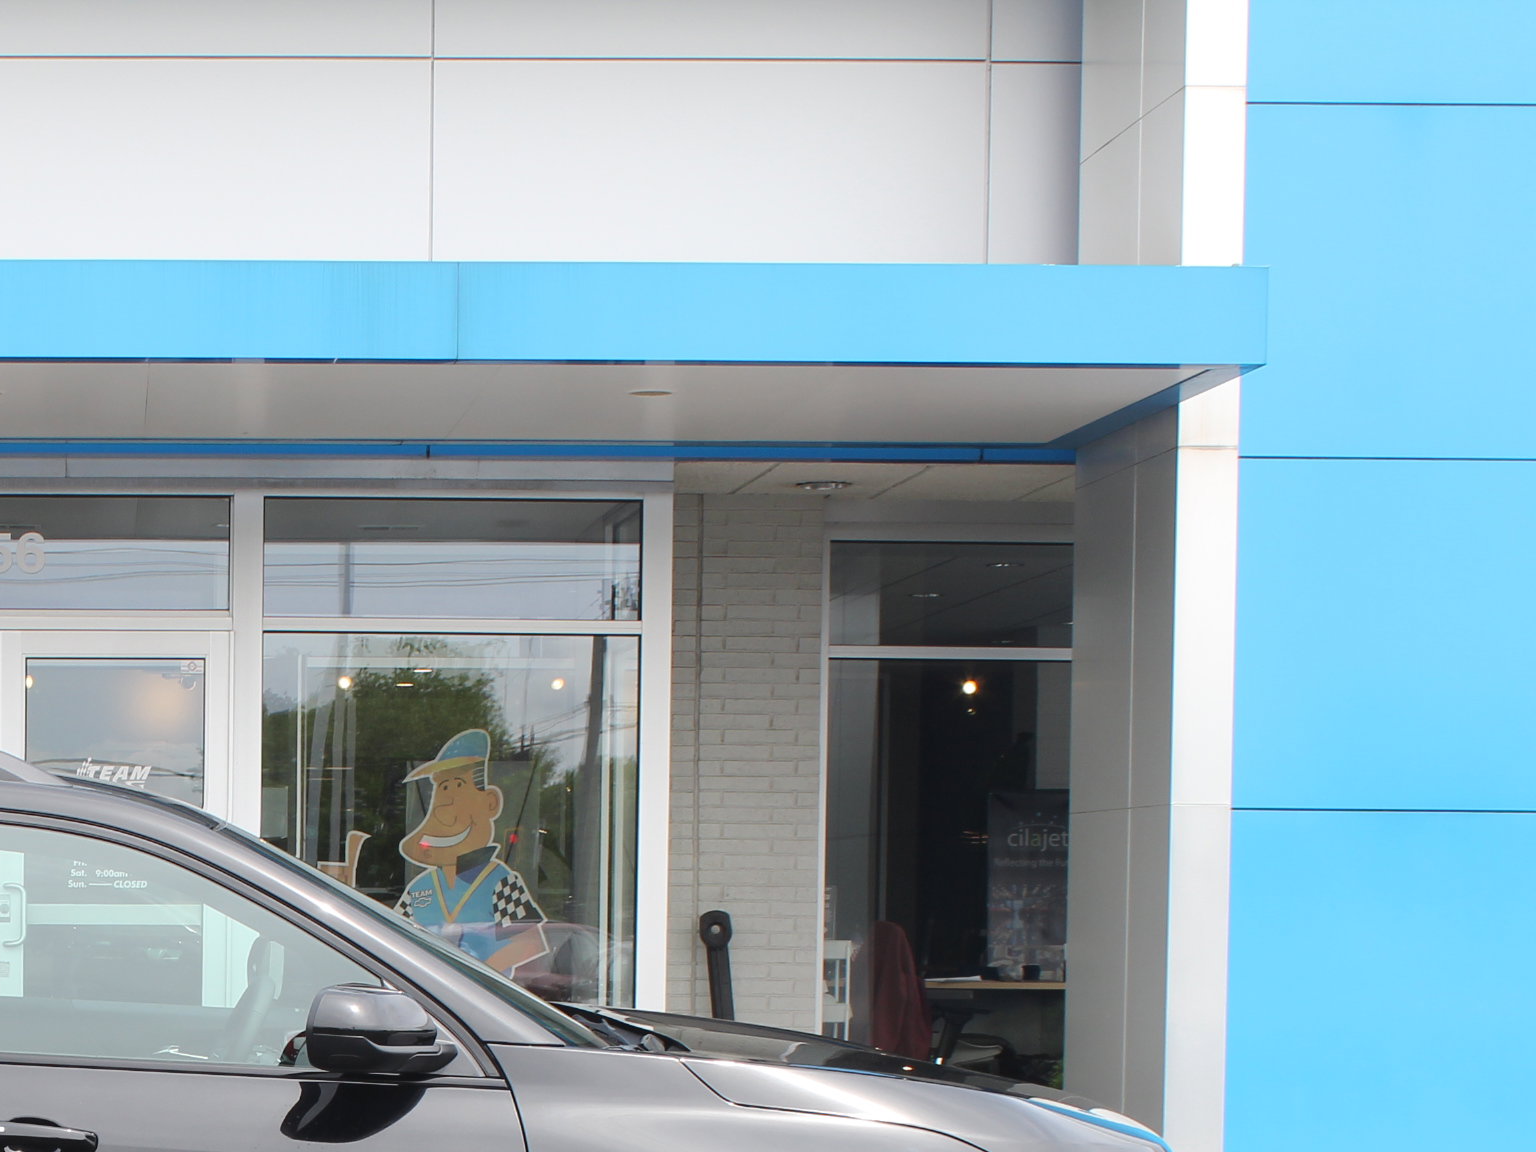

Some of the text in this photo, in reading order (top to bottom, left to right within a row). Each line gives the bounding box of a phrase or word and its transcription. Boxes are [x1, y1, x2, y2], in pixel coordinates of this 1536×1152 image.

[88, 765, 152, 783] TEAM
[1007, 828, 1068, 852] cilajet
[113, 880, 148, 889] CLOSED
[411, 890, 433, 898] TEAM
